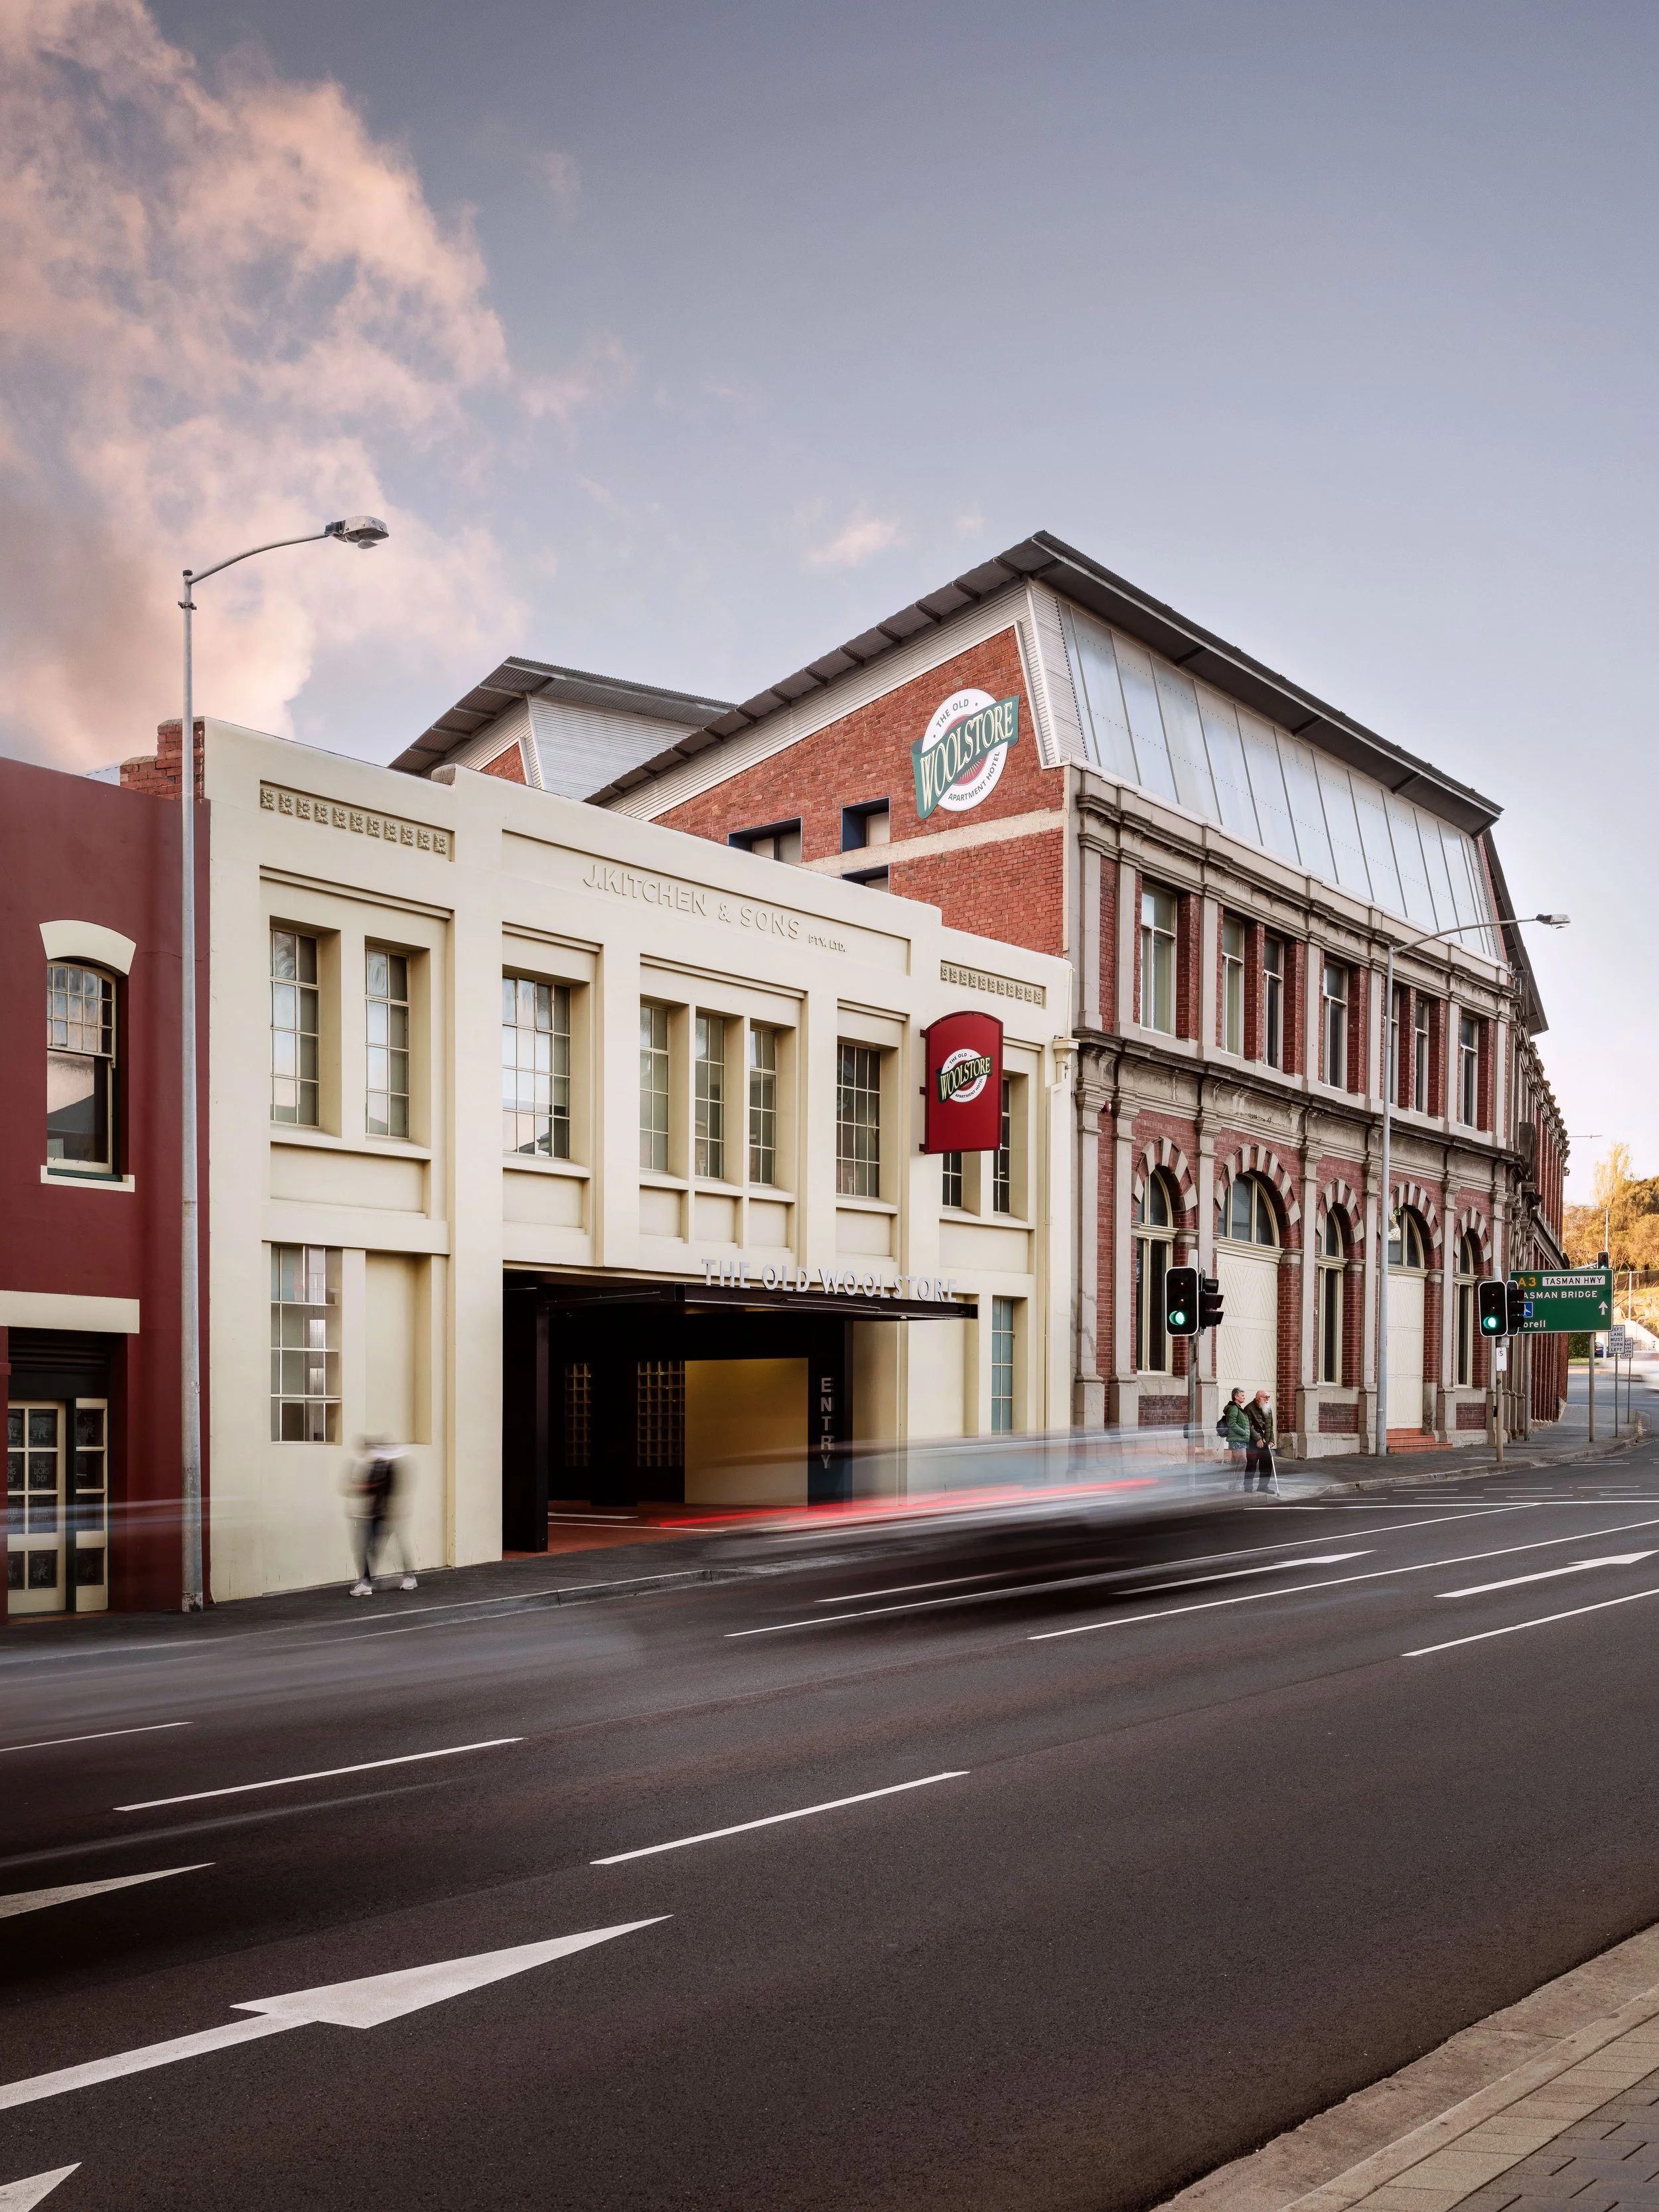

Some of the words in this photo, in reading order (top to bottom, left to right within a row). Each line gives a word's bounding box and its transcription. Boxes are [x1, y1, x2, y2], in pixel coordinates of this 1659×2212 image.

[936, 709, 951, 728] THE
[952, 699, 969, 711] OLD
[920, 701, 1014, 812] WOOLSTORE
[948, 781, 987, 802] APARTMENT
[986, 751, 1000, 781] HOTEL
[719, 902, 731, 923] &
[740, 905, 800, 940] SONS
[808, 934, 827, 948] PTY.
[830, 939, 847, 952] LTD.
[940, 1057, 991, 1100] WOOLSTORE
[949, 1056, 958, 1065] THE
[955, 1090, 976, 1098] APARTMENT
[701, 1259, 751, 1288] THE
[762, 1264, 810, 1293] OLD
[818, 1268, 958, 1303] WOOLSTORE
[821, 1378, 835, 1469] ENTRY
